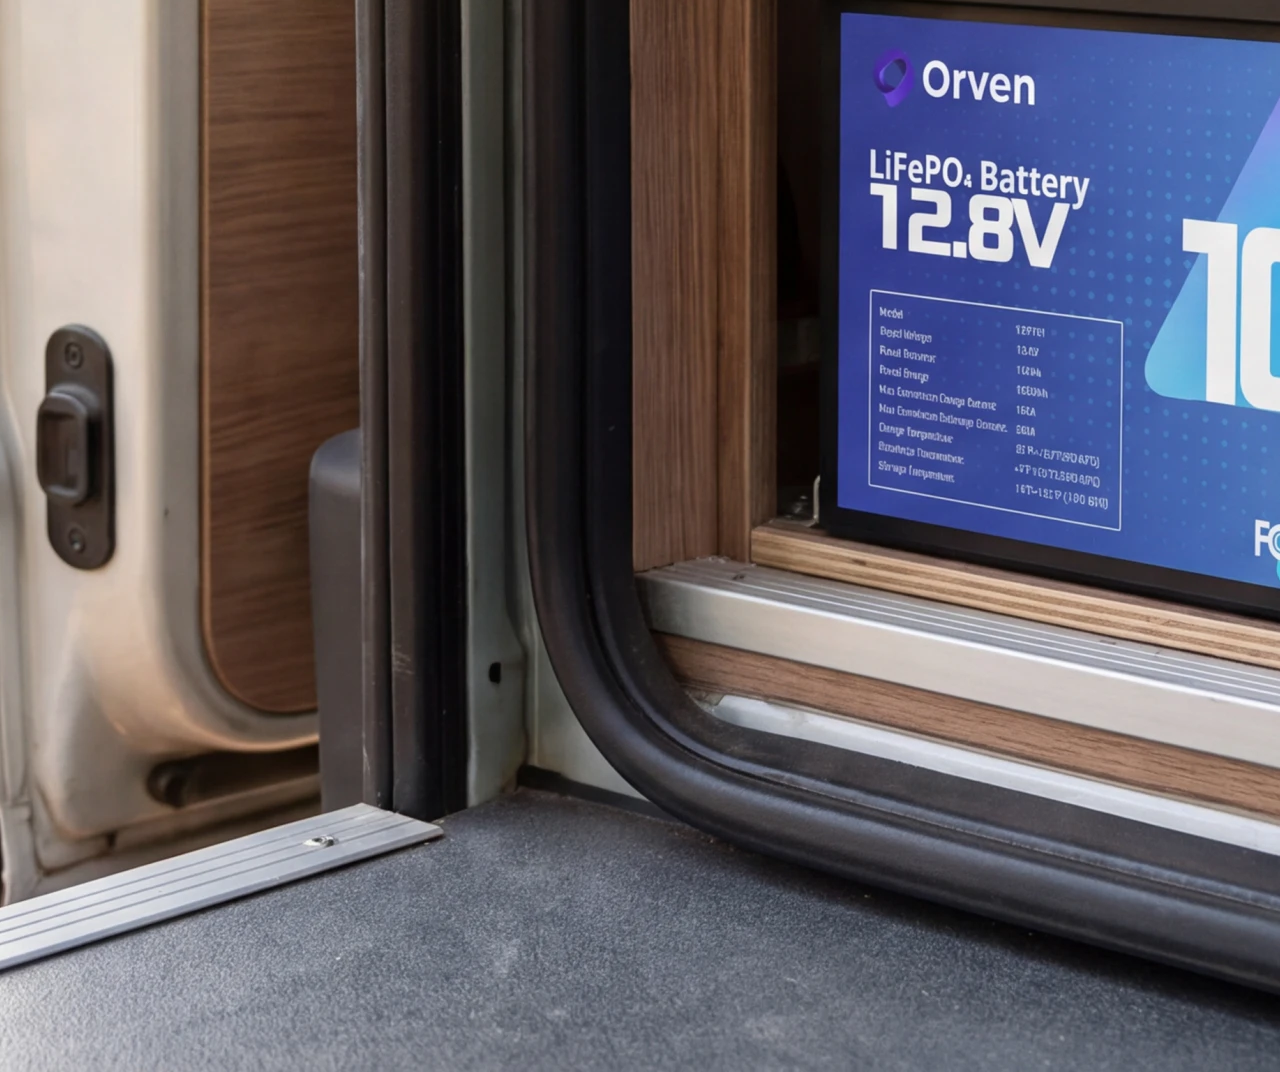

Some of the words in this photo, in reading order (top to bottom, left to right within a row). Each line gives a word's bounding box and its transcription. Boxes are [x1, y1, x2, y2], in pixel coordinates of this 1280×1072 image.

[922, 59, 1036, 106] Orven
[980, 159, 1091, 211] Battery
[869, 181, 1071, 270] 12.8V
